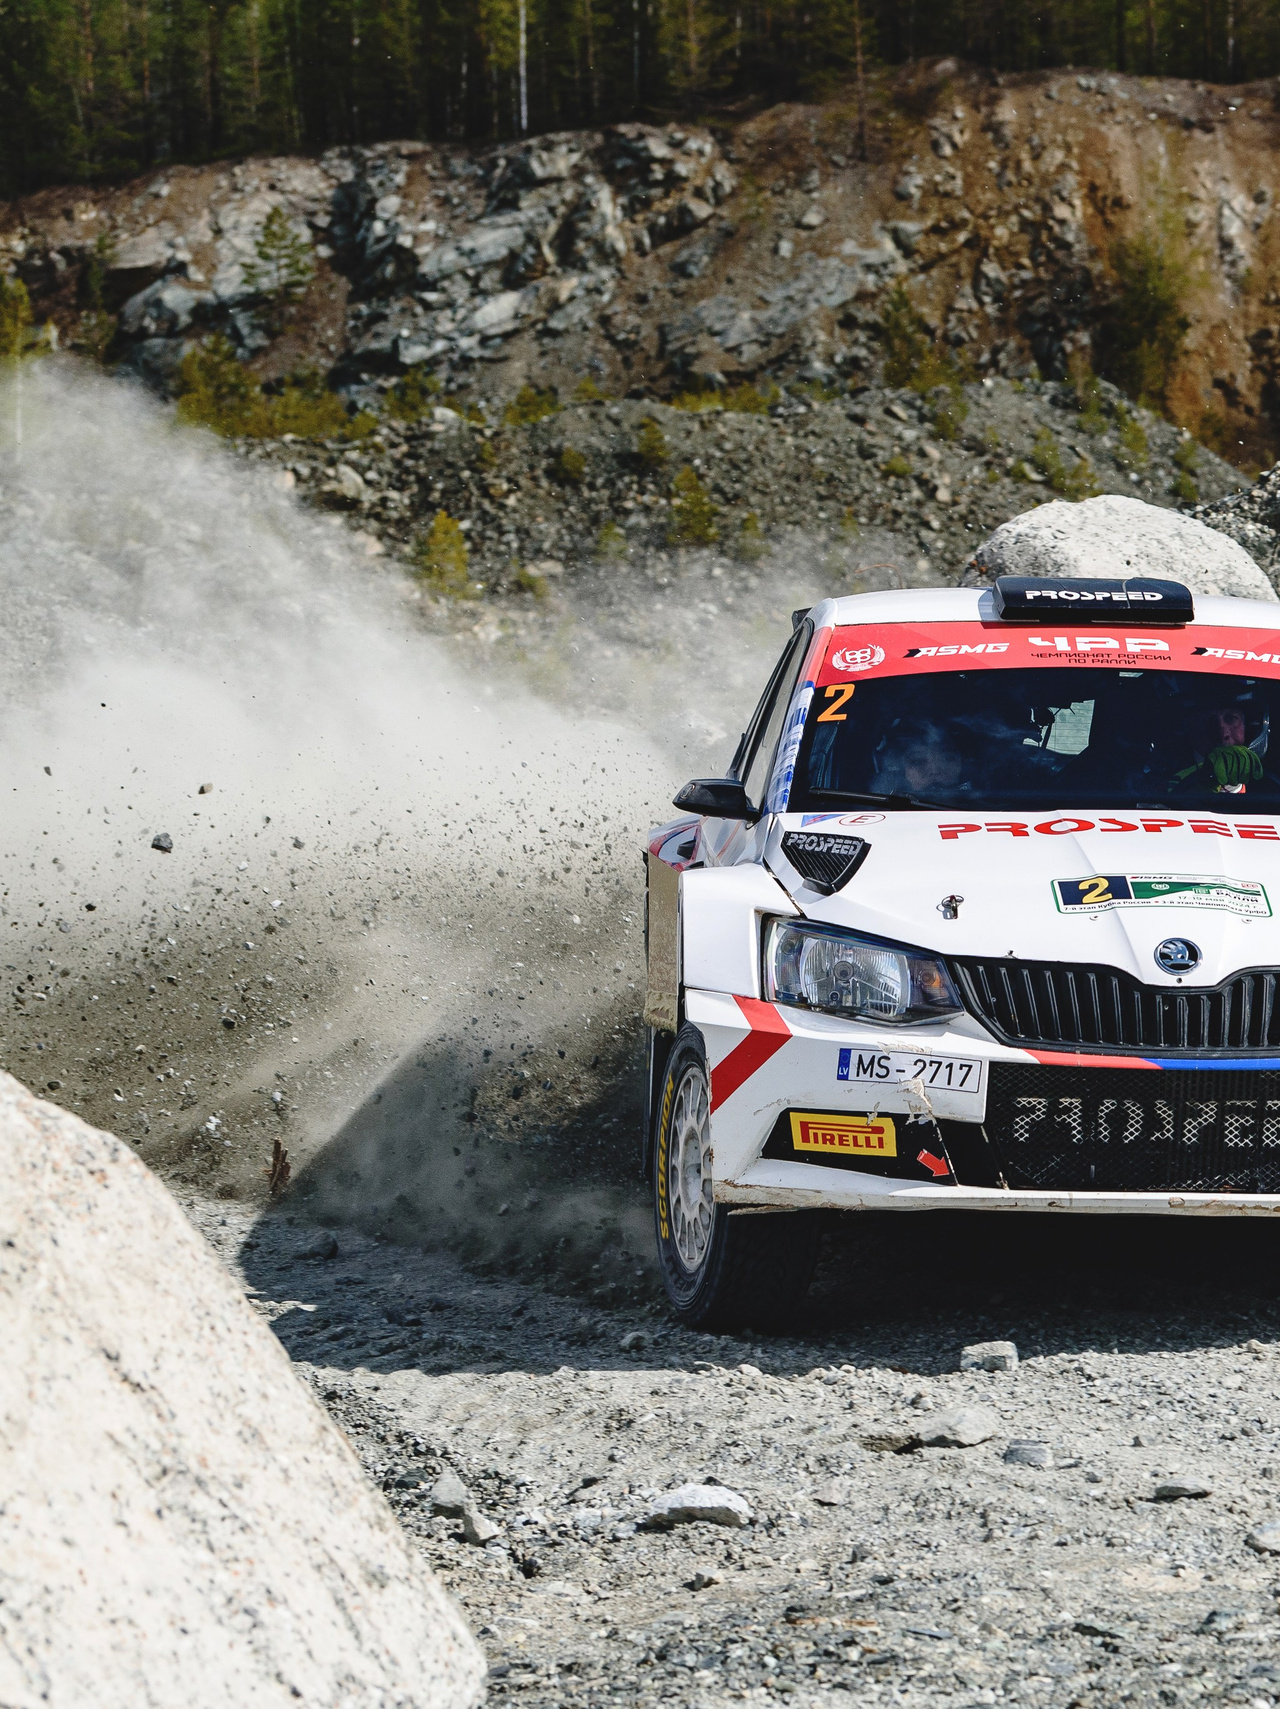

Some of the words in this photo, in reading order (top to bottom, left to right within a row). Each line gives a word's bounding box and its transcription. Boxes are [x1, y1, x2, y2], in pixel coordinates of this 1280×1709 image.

[1025, 590, 1164, 601] PROSPEED
[914, 642, 1010, 658] ASMG
[1028, 636, 1170, 653] ЧРР
[1031, 652, 1113, 660] ЧЕМПИОНАТ
[1118, 653, 1172, 662] РОССИИ
[1091, 658, 1137, 666] РАЛЛИ
[816, 683, 856, 722] 2
[786, 833, 863, 855] PROSPEED
[1078, 877, 1113, 904] 2
[839, 1067, 849, 1076] LV
[800, 1120, 885, 1150] PIRELLI
[658, 1072, 675, 1240] SCORPION
